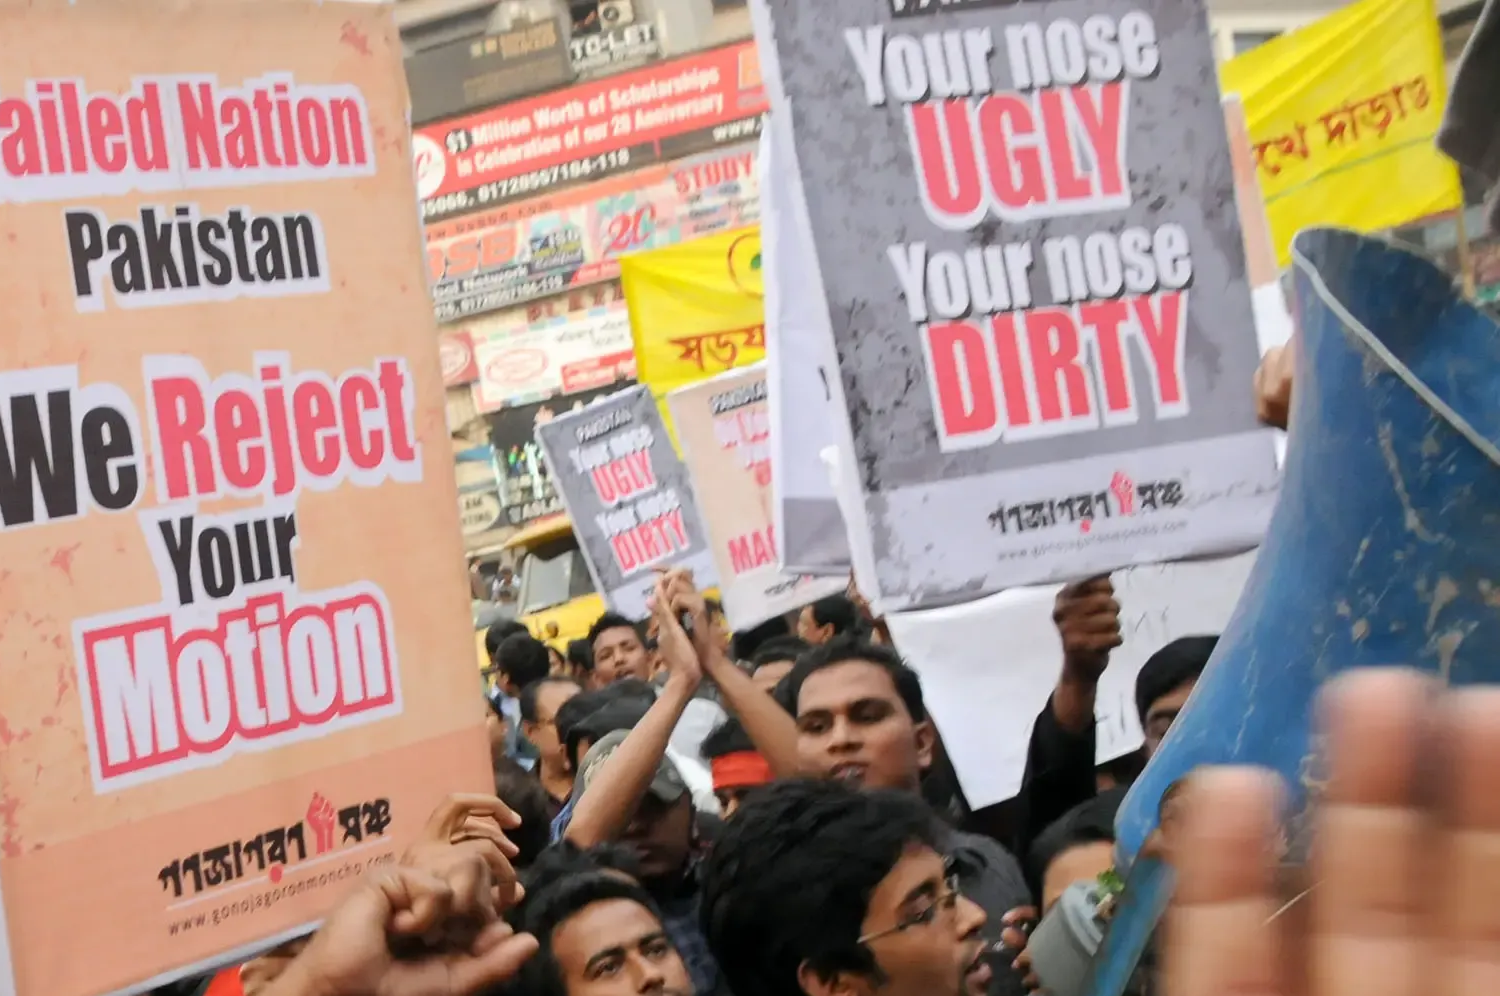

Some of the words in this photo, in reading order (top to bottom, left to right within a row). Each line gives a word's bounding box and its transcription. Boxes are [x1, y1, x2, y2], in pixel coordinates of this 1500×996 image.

[846, 23, 994, 106] Your
[1005, 10, 1160, 91] nose
[176, 81, 368, 171] Nation
[471, 117, 532, 147] Million
[533, 98, 585, 129] Worth
[589, 93, 606, 117] of
[609, 66, 720, 111] Scholarships
[475, 134, 562, 173] Celebration
[564, 126, 580, 149] of
[635, 93, 724, 131] Anniversary
[908, 80, 1130, 218] UGLY
[673, 152, 754, 193] STUDY
[65, 207, 320, 296] Pakistan
[887, 237, 1033, 323] Your
[1043, 223, 1194, 302] nose
[925, 291, 1185, 440] DIRTY
[152, 360, 415, 500] Reject
[591, 448, 656, 507] UGLY
[159, 511, 297, 605] Your
[611, 508, 689, 577] DIRTY
[82, 593, 394, 780] Motion
